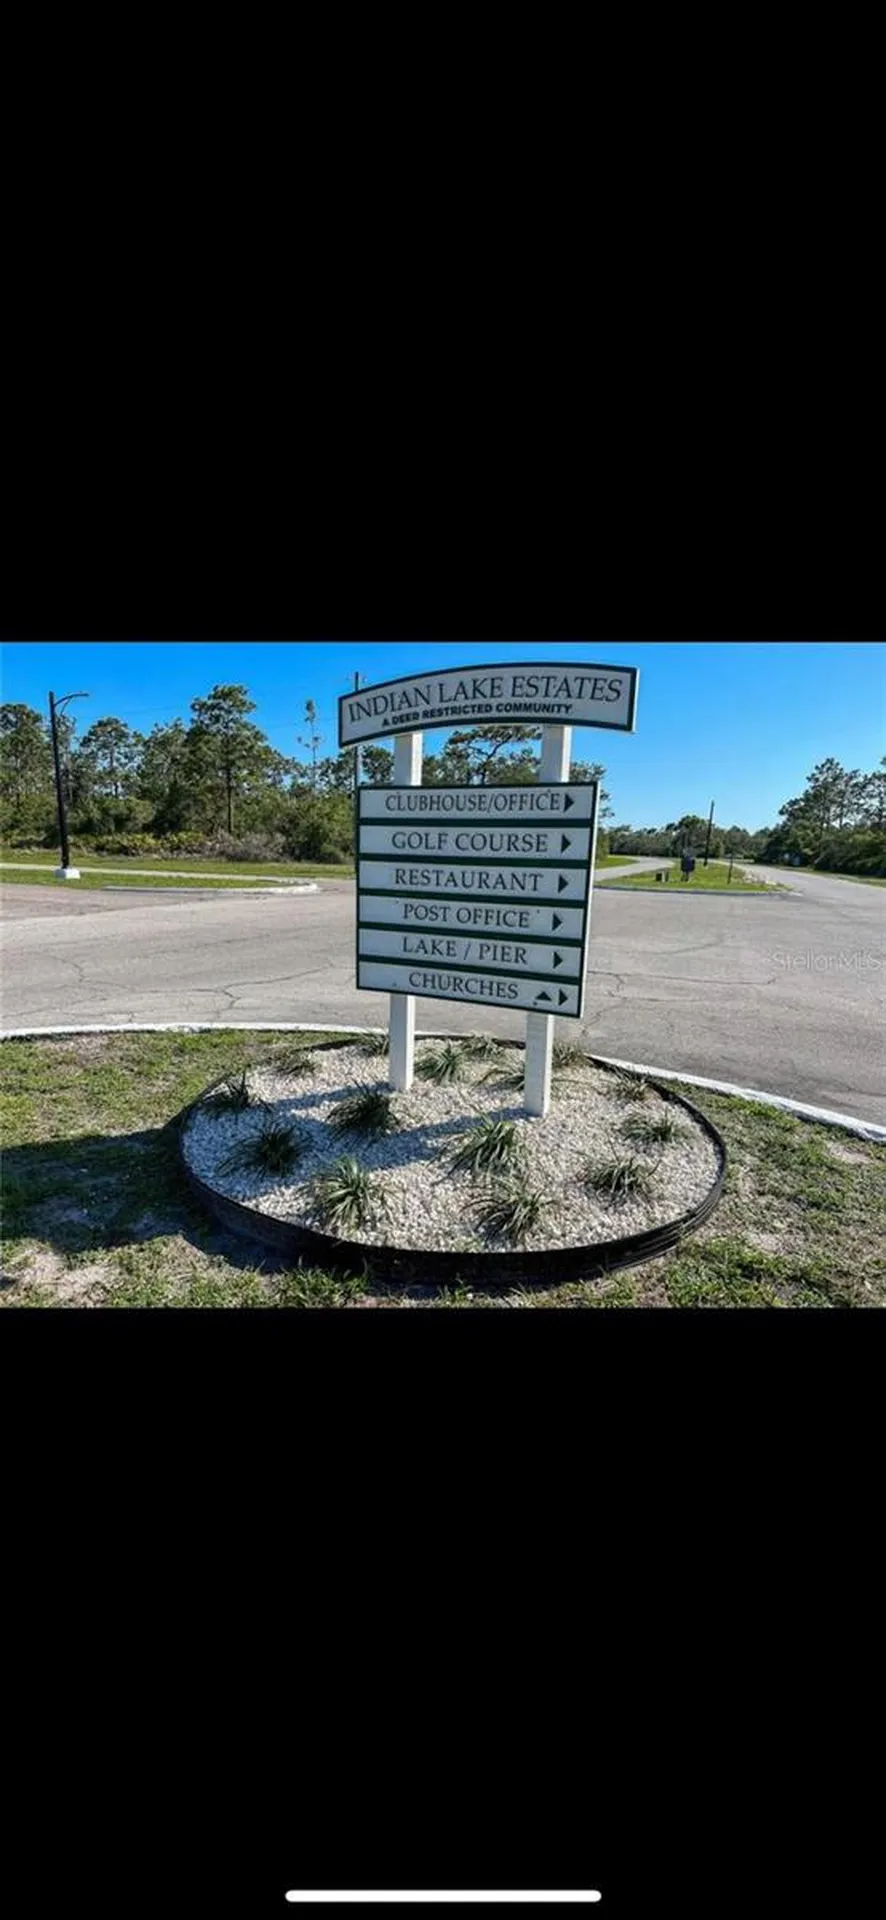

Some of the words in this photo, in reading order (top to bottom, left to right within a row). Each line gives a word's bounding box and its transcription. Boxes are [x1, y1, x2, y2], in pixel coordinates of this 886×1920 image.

[349, 684, 431, 722] INDIAN
[437, 676, 503, 703] LAKE
[511, 675, 623, 702] ESTATES
[381, 718, 390, 727] A
[392, 711, 419, 725] DEED
[422, 703, 492, 719] RESTRICTED
[496, 702, 573, 714] COMMUNITY
[385, 791, 560, 813] CLUBHOUSE/OFFICE
[391, 831, 449, 850] GOLF
[455, 833, 548, 853] COURSE
[394, 868, 543, 891] RESTAURANT
[403, 903, 451, 922] POST
[456, 906, 531, 928] OFFICE
[402, 937, 457, 957] LAKE
[463, 944, 472, 960] /
[479, 944, 528, 964] PIER
[409, 971, 519, 999] CHURCHES
